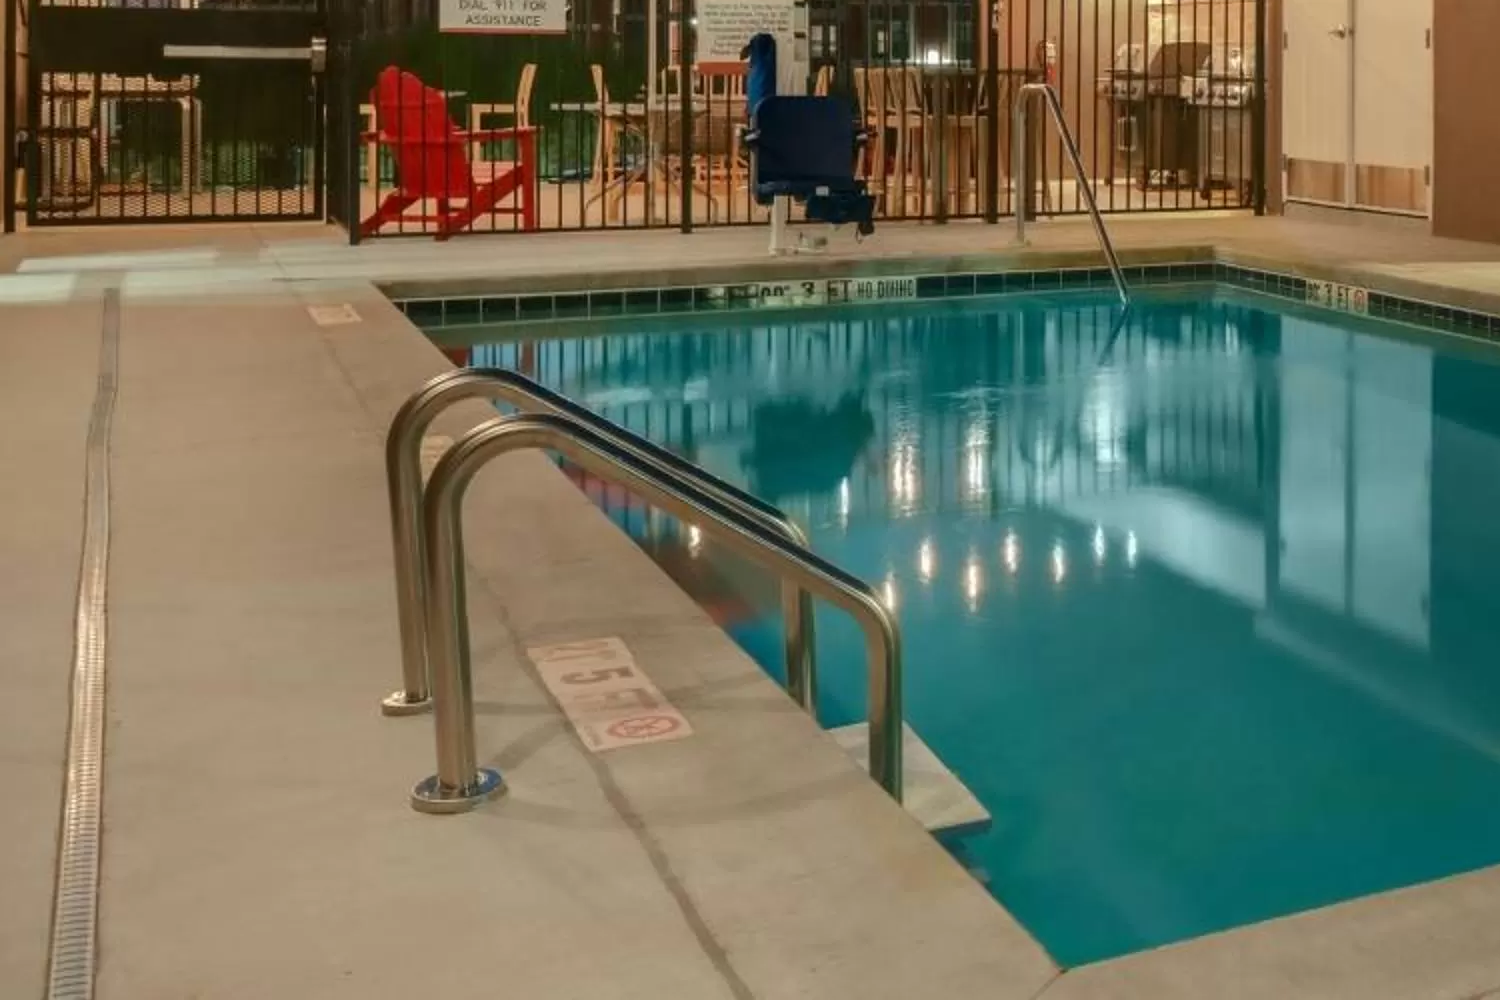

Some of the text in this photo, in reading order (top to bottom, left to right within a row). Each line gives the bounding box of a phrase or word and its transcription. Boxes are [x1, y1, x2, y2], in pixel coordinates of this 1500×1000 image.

[523, 0, 548, 12] FOR
[465, 14, 541, 27] ASSISTANCE
[560, 666, 635, 685] 5
